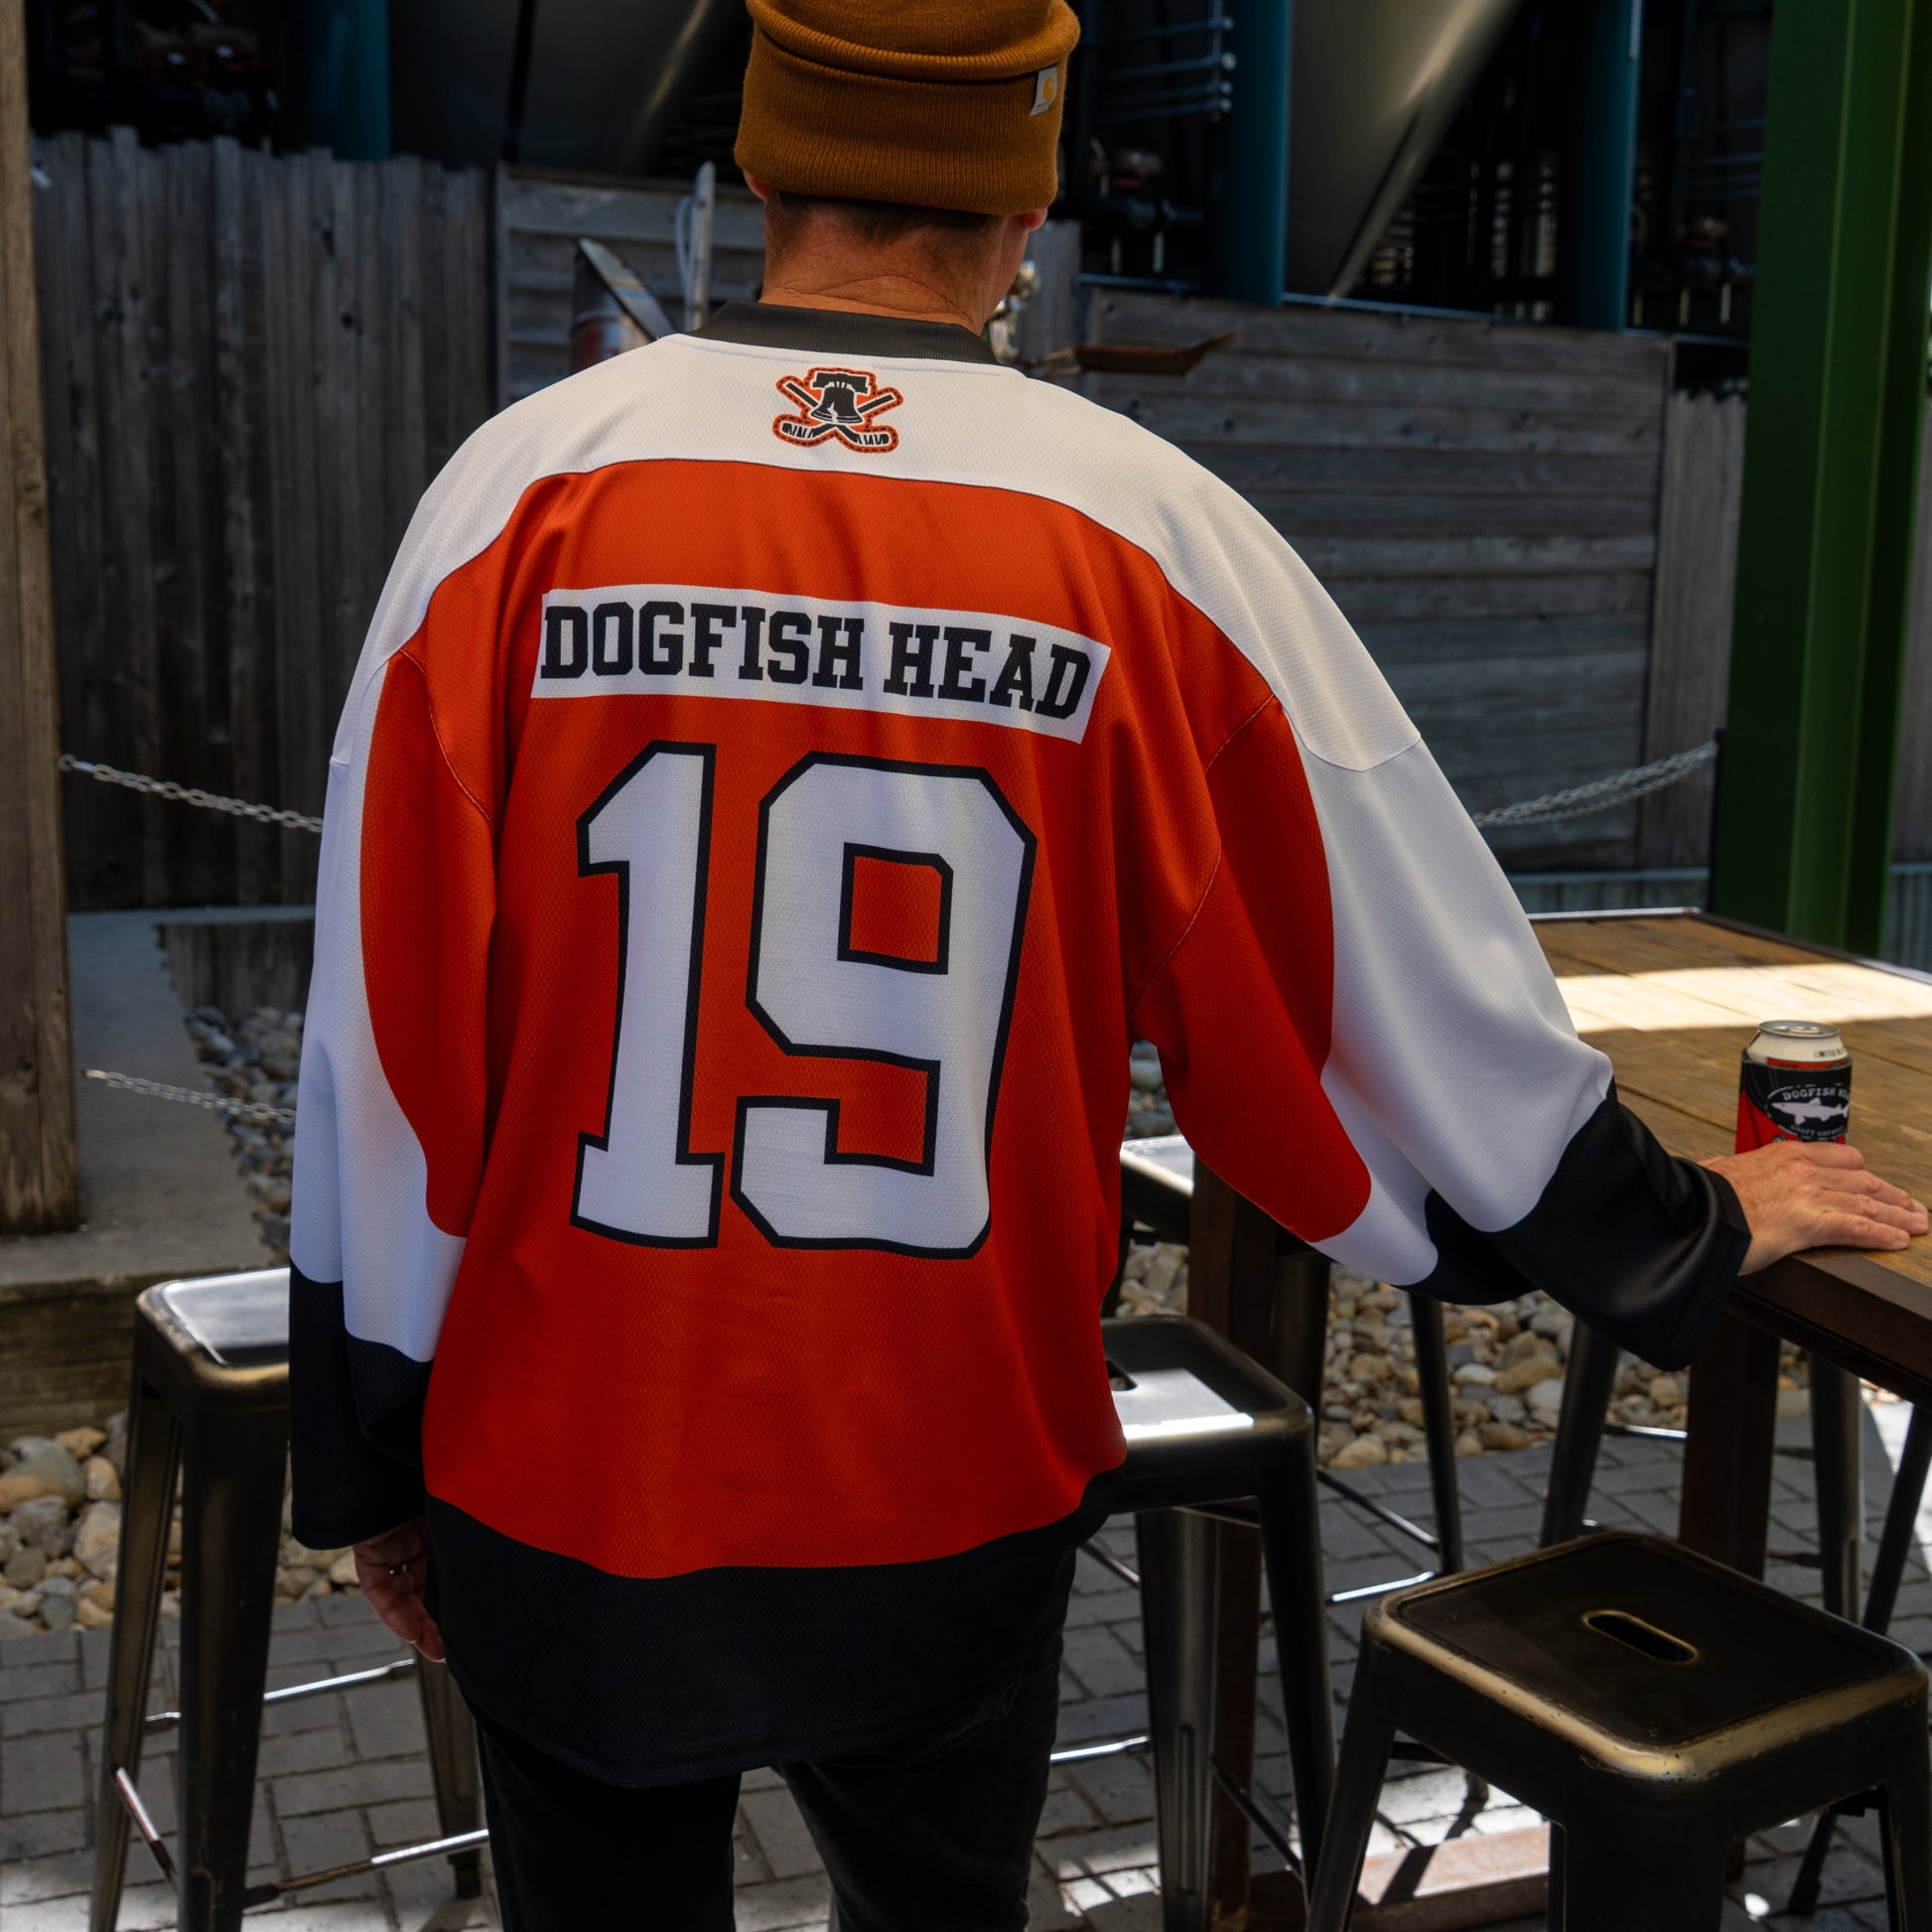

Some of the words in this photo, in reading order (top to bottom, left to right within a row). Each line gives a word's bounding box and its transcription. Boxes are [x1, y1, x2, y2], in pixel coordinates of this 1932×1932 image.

[540, 601, 865, 690] DOGFISH
[883, 621, 1091, 720] HEAD
[570, 739, 1038, 1260] 19
[1782, 1087, 1836, 1101] DOGFISH
